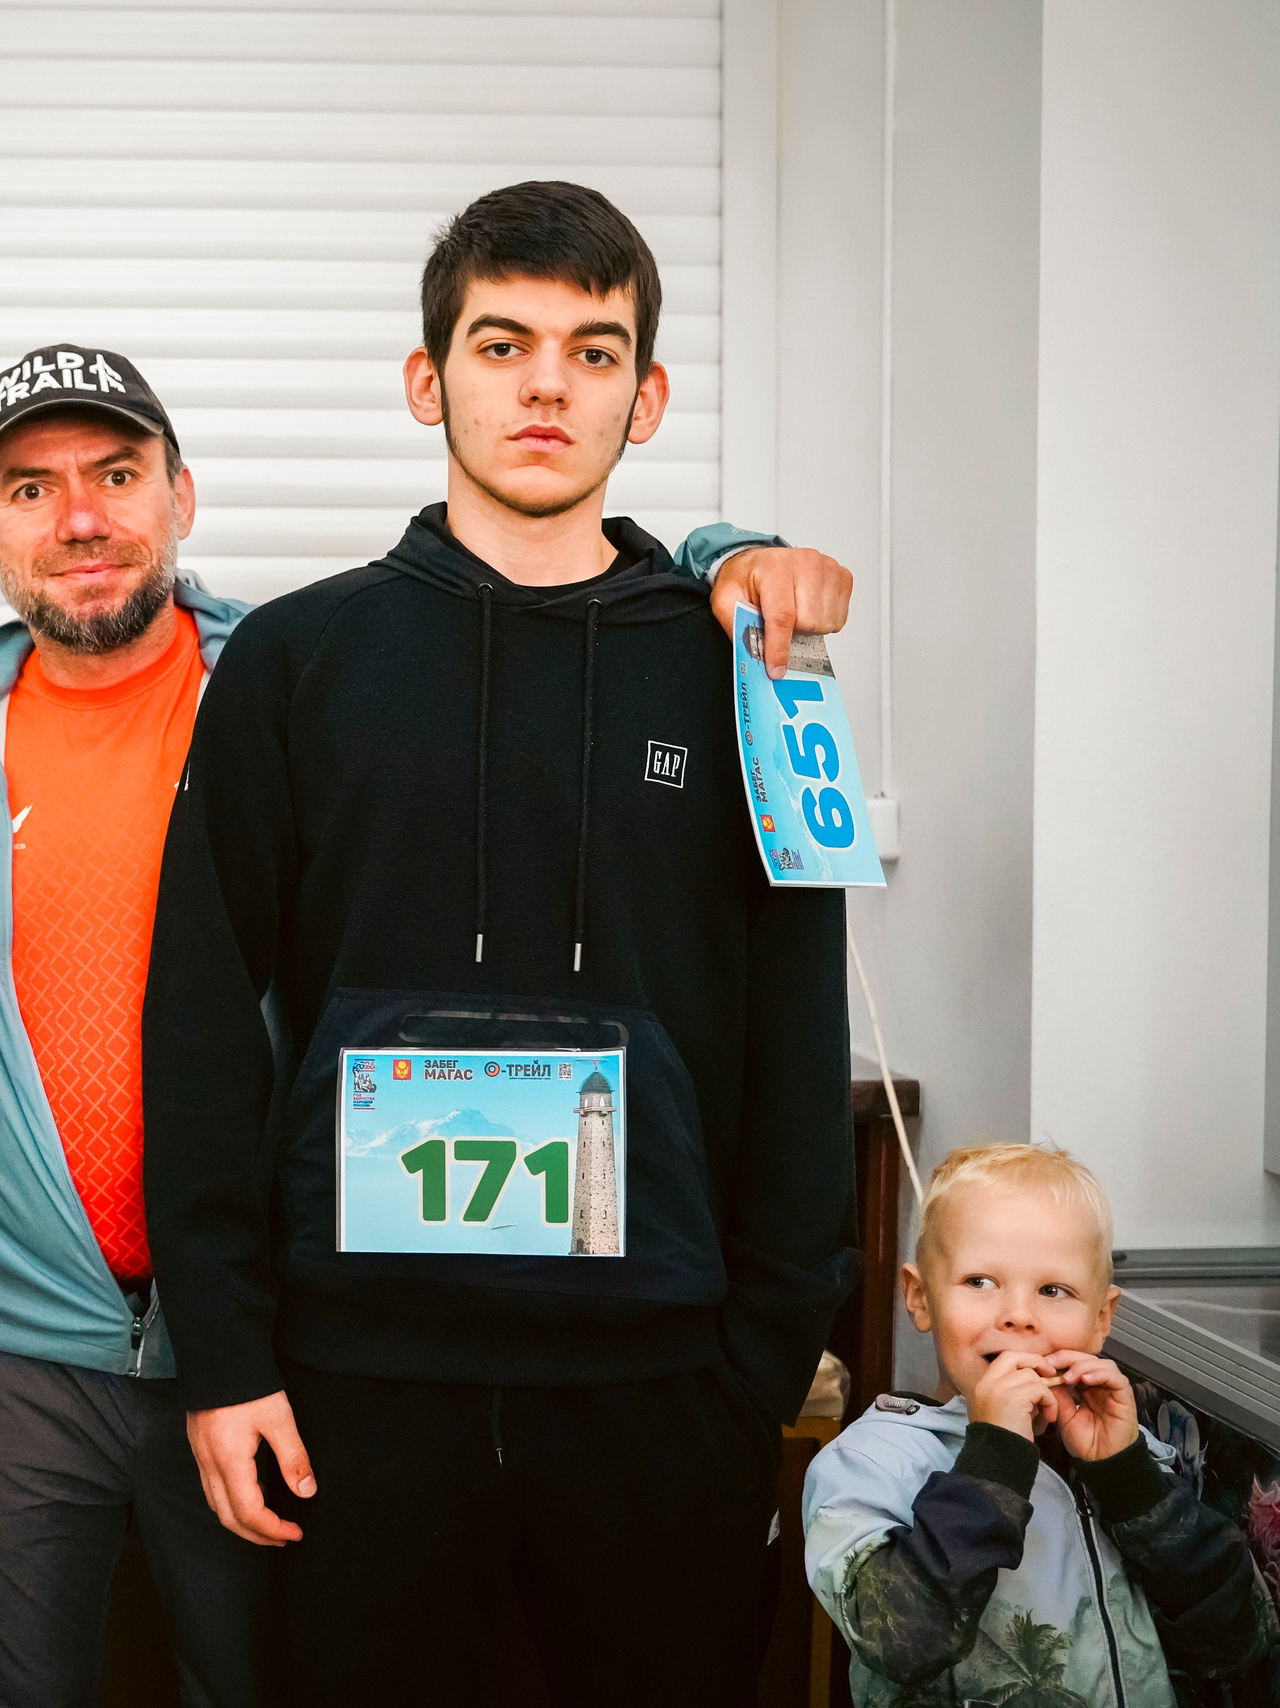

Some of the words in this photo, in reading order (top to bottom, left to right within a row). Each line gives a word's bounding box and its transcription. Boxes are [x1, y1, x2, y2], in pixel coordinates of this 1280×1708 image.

[653, 750, 681, 777] GAP
[772, 679, 856, 849] 651
[750, 770, 762, 802] ЗАБЕГ
[752, 757, 769, 803] МАГАС
[424, 1059, 459, 1069] ЗАБЕГ
[424, 1069, 474, 1080] МАГАС
[400, 1139, 569, 1224] 171
